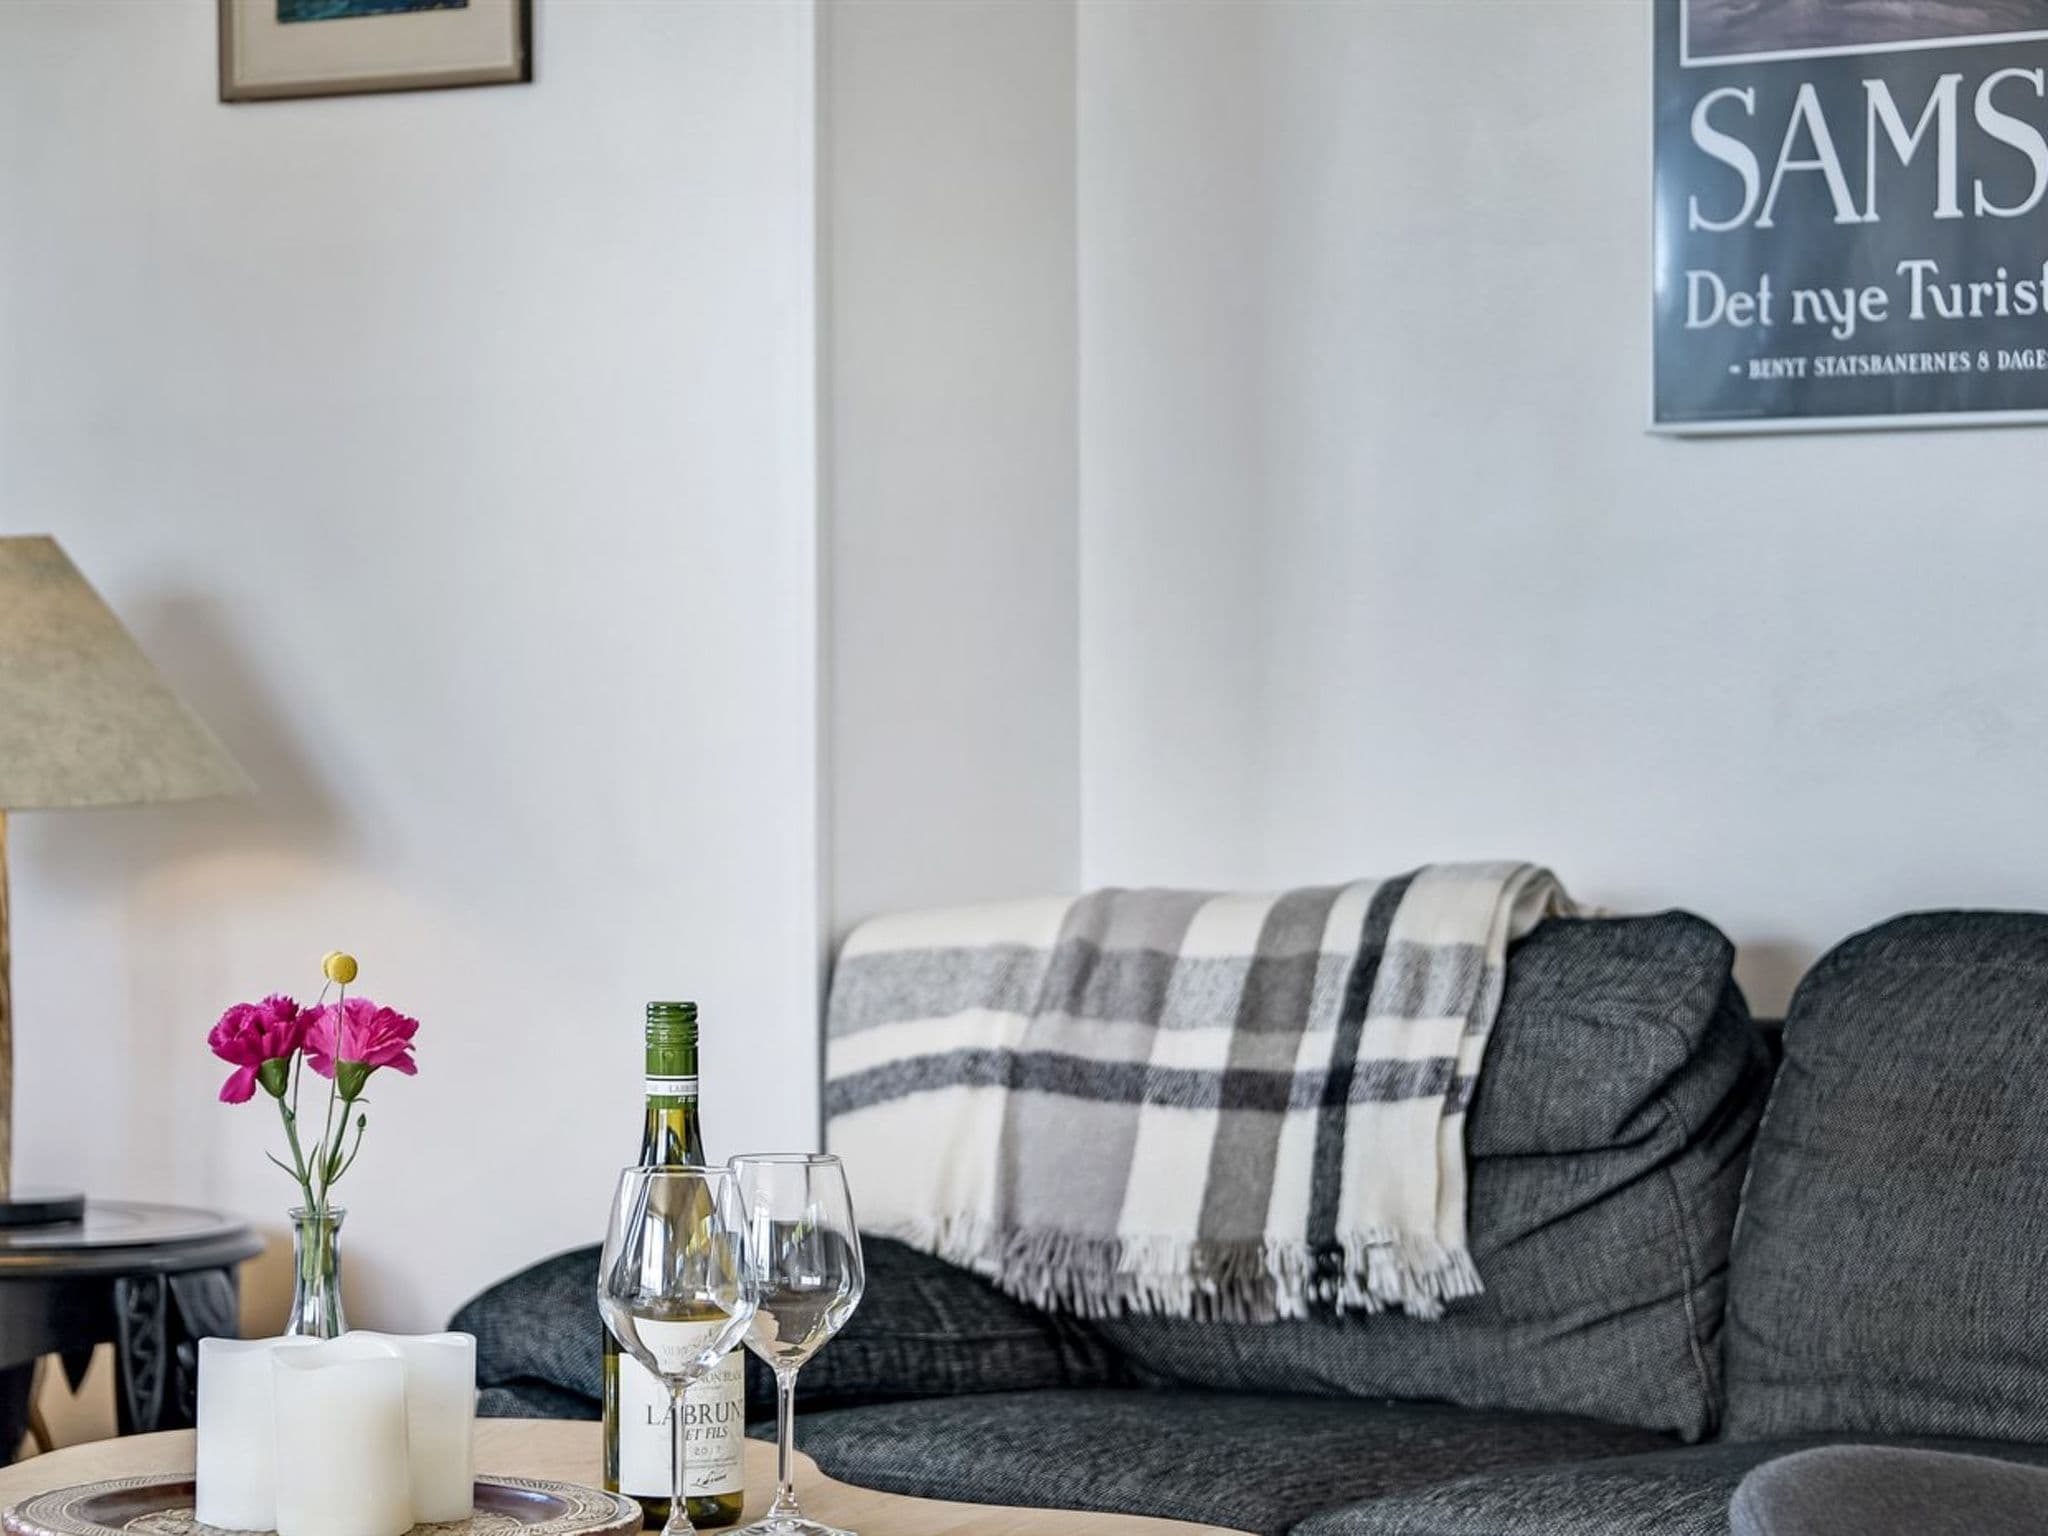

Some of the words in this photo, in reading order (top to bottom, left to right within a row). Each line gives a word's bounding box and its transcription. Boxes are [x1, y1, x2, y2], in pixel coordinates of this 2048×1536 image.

[1685, 270, 1774, 330] Det
[1791, 287, 1888, 341] nye
[1748, 357, 1806, 380] BENYT
[1814, 352, 1971, 377] STATSBANERNES
[1977, 352, 1990, 371] 8
[685, 1428, 702, 1441] ET
[705, 1426, 728, 1440] FILS
